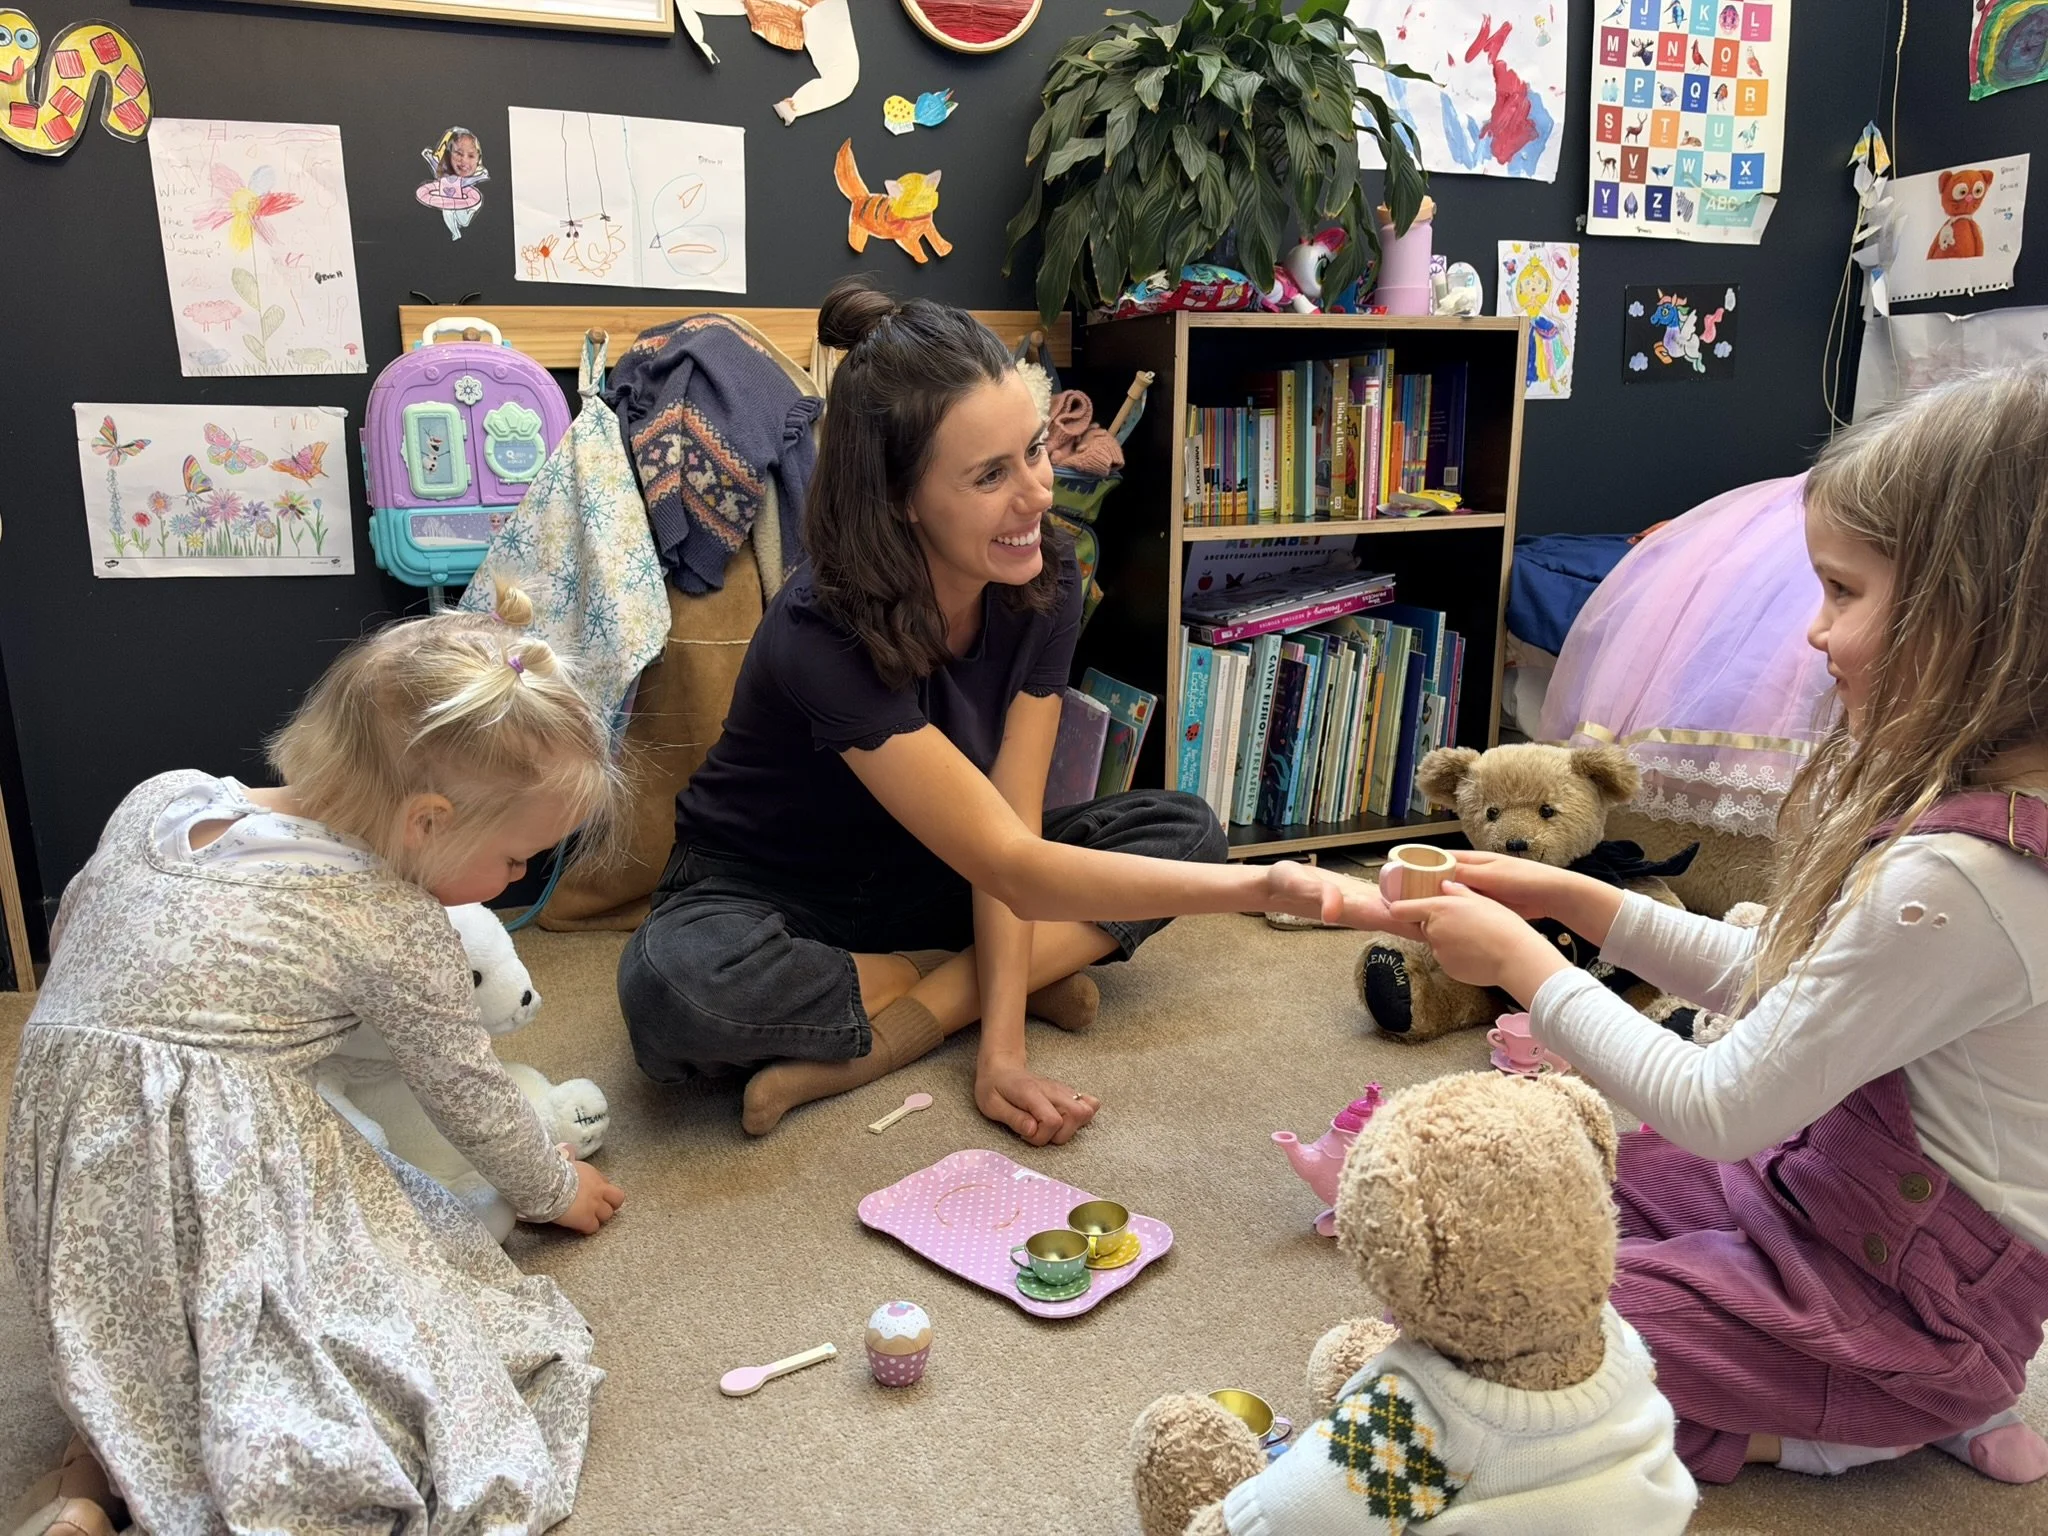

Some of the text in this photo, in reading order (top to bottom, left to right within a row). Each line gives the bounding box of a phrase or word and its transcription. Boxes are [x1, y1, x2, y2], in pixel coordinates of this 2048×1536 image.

[1640, 0, 1760, 28] J K L
[1607, 35, 1731, 63] M N O
[1634, 77, 1756, 102] P Q R
[1605, 113, 1724, 138] S T U
[1629, 153, 1752, 176] V W X
[159, 183, 196, 197] Where
[1601, 188, 1737, 212] Y Z ABC
[164, 216, 184, 227] the
[1336, 437, 1344, 456] Klint
[1266, 655, 1277, 690] GAVIN
[1187, 672, 1198, 717] Ladybird
[1258, 694, 1270, 740] BISHOP
[1247, 753, 1261, 808] TREASURY
